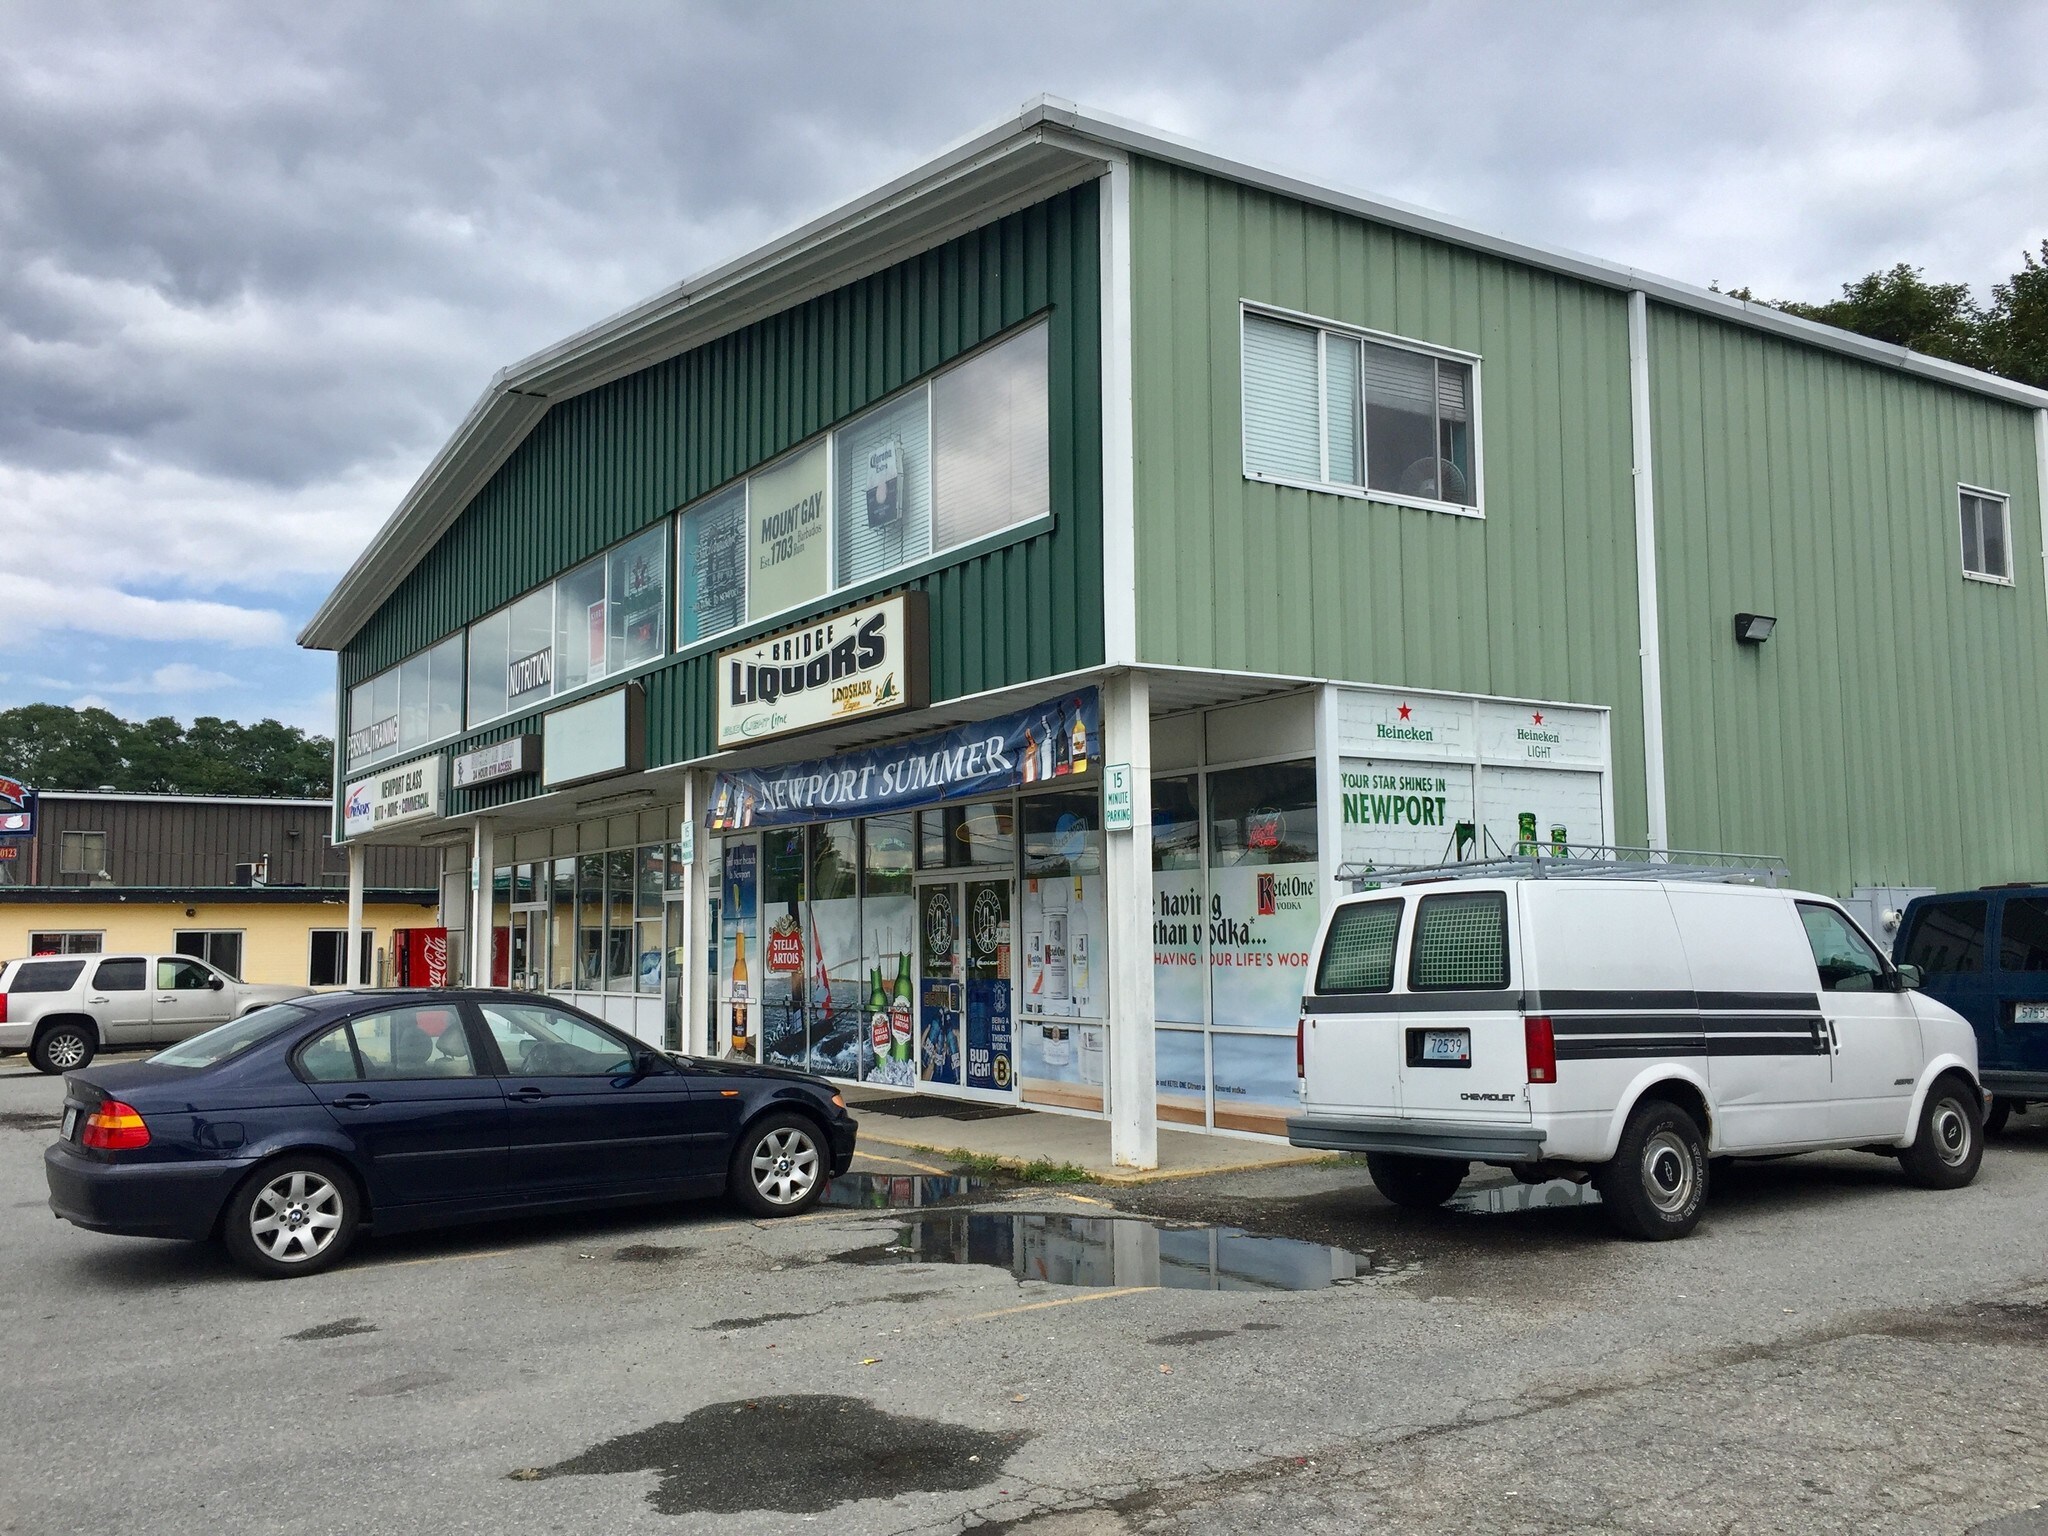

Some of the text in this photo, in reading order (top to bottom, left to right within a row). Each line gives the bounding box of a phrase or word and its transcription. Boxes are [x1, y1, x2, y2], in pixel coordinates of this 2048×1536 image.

[761, 490, 822, 544] MOUNT GAY
[770, 535, 793, 566] 1703
[772, 624, 834, 661] BRIDGE
[731, 612, 887, 706] LIQUORS
[509, 649, 551, 697] NUTRITION
[831, 680, 872, 703] LANDSHARK
[372, 716, 398, 751] TRAINING
[1376, 723, 1434, 741] Heineken
[1517, 728, 1560, 744] Heineken
[1527, 745, 1551, 759] LIGHT
[759, 734, 1013, 811] NEWPORT SUMMER
[1113, 772, 1123, 788] 15
[381, 769, 423, 799] NEWPORT GLASS
[1341, 773, 1446, 792] YOUR STAR SHINES IN
[387, 801, 399, 817] HOME
[402, 792, 430, 814] COMMERCIAL
[1108, 791, 1129, 805] MINUTE
[1107, 808, 1131, 822] PARKING
[1342, 793, 1447, 826] NEWPORT
[1291, 876, 1314, 898] One
[1276, 901, 1301, 910] VODKA
[1153, 919, 1188, 946] than
[773, 939, 799, 950] STELLA
[772, 952, 799, 964] ARTOIS
[1154, 952, 1197, 966] HAVING
[1236, 952, 1273, 967] LIFE'S
[991, 1016, 1005, 1024] BEING
[2022, 1006, 2048, 1019] 5755
[991, 1024, 1000, 1032] FAN
[991, 1034, 1011, 1043] THIRSTY
[1431, 1038, 1462, 1053] 72539
[969, 1048, 989, 1063] BUD
[1460, 1093, 1516, 1102] CHEVROLET
